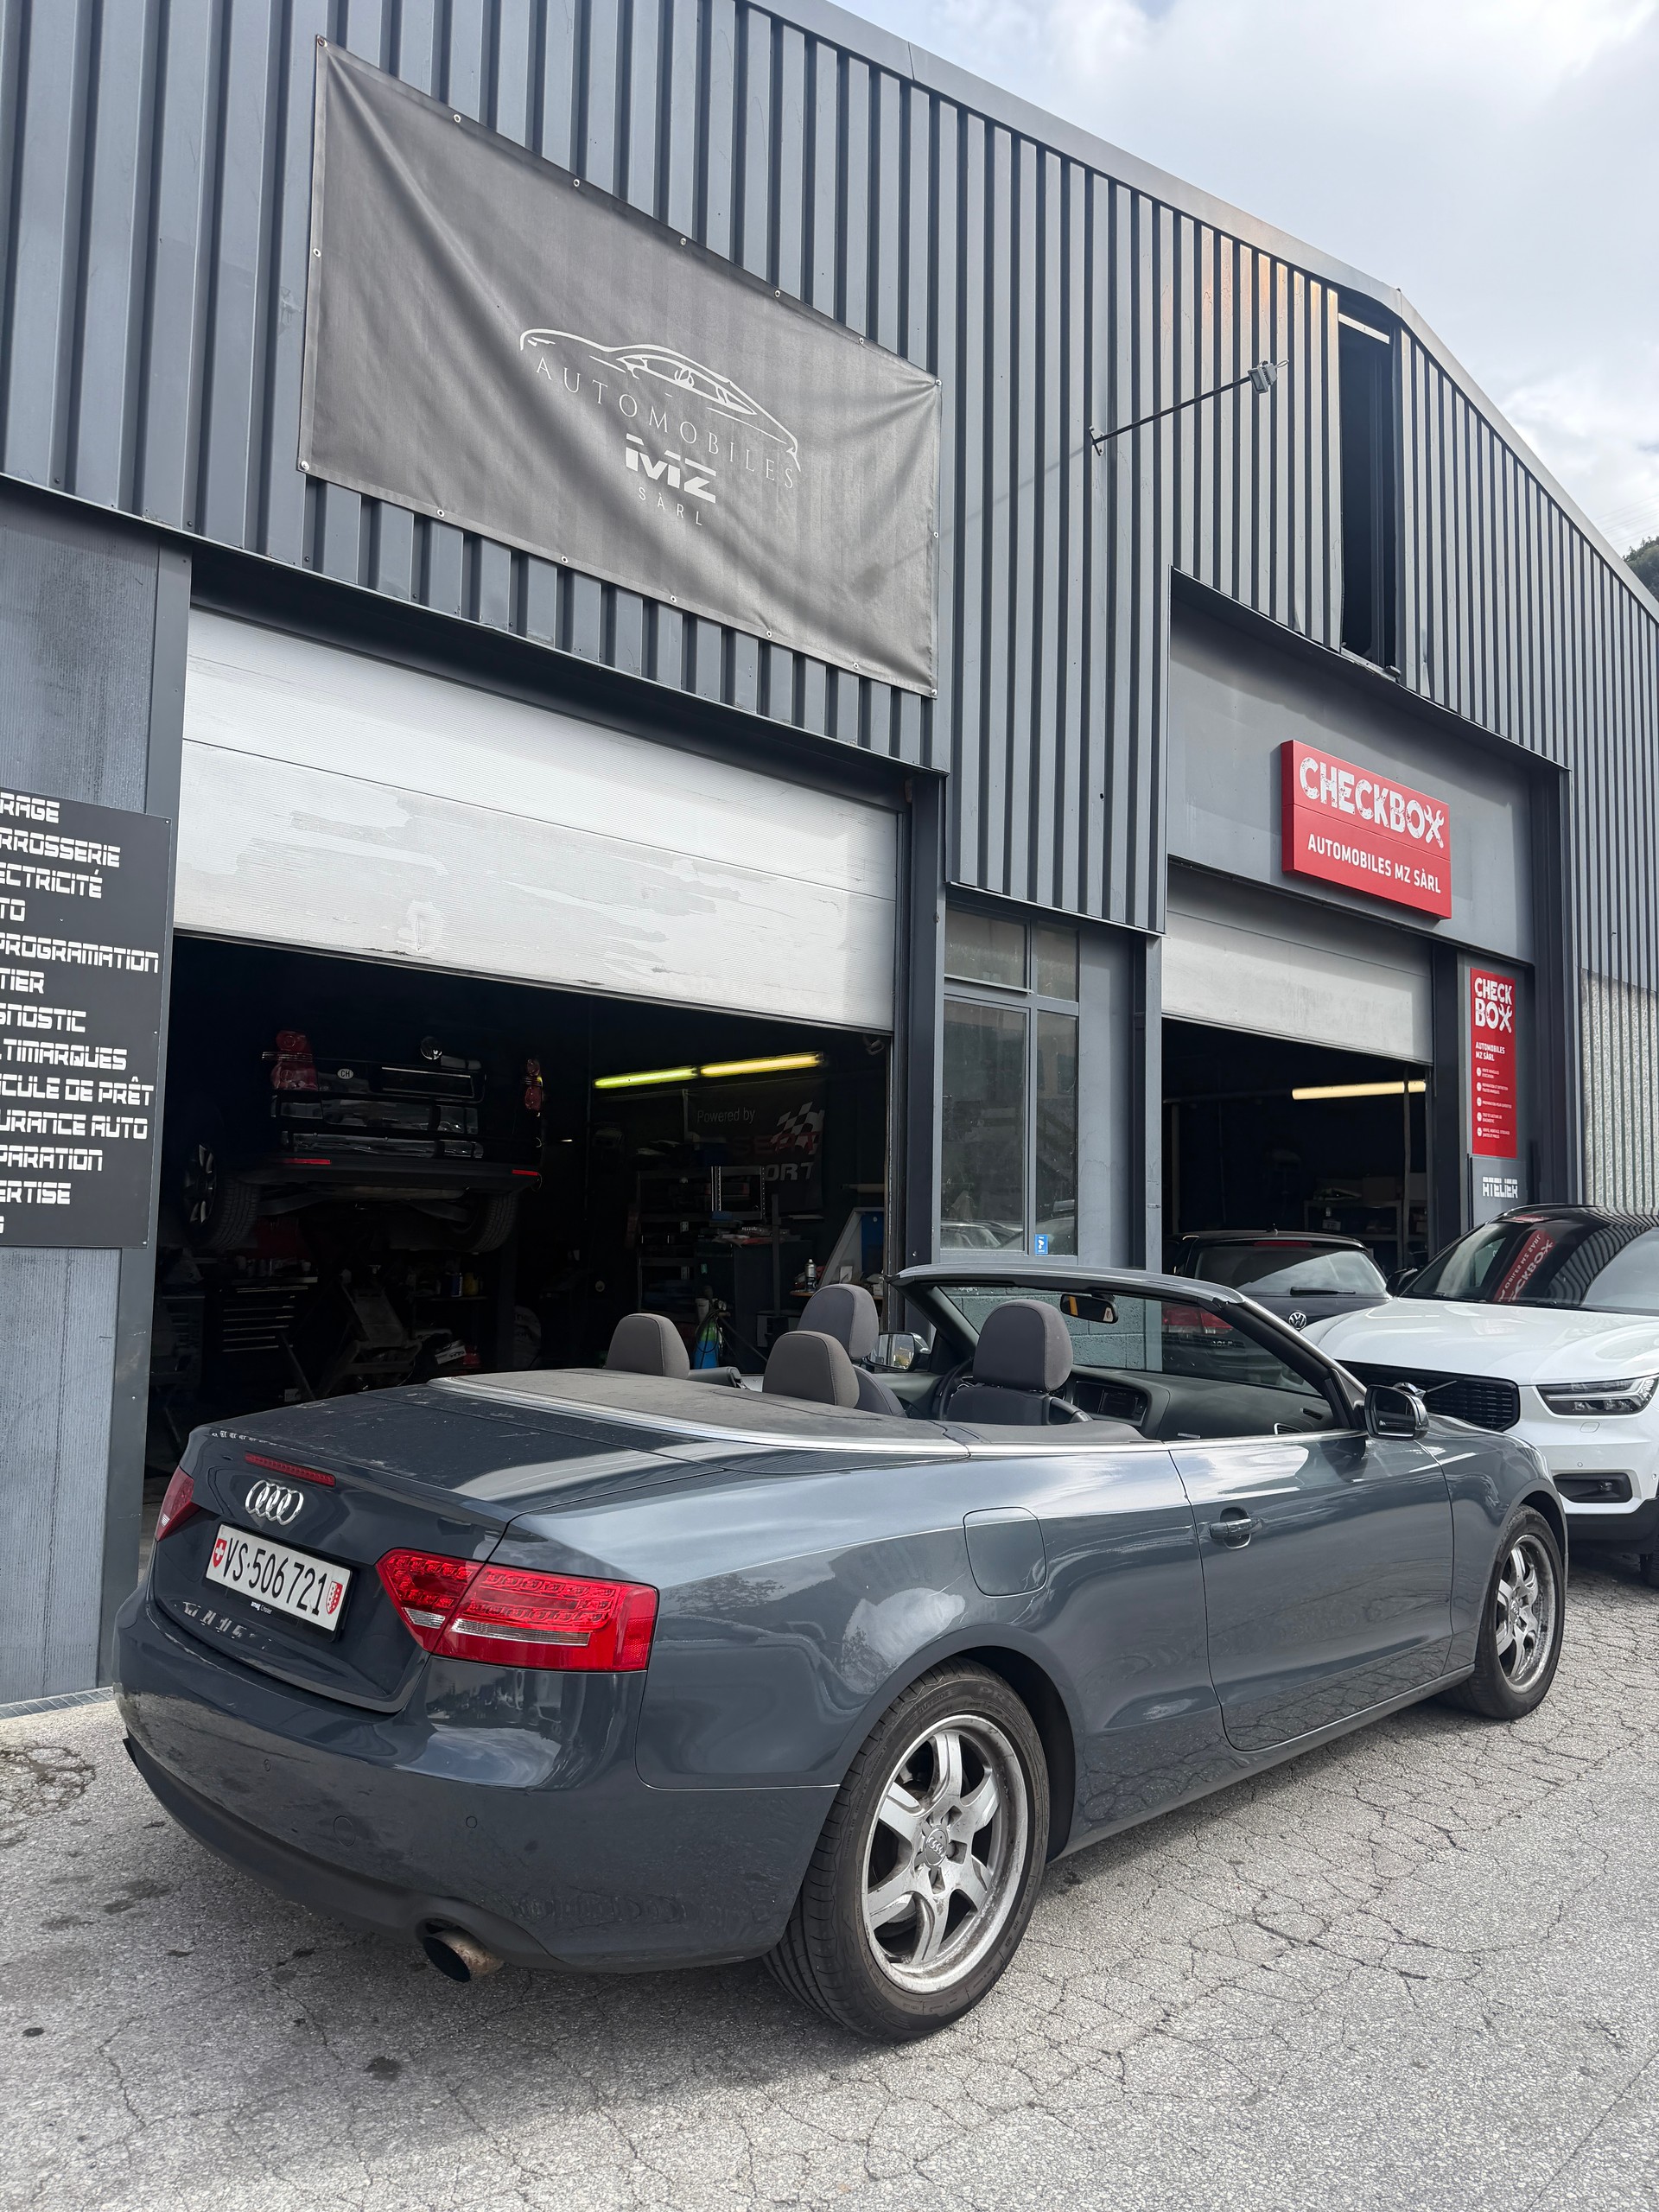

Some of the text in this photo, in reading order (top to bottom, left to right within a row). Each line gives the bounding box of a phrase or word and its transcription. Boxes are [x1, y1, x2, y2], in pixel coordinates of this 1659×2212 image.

[536, 356, 794, 489] AUTOMOBILES
[638, 486, 702, 526] SÀRL
[0, 791, 60, 824] RAGE
[1299, 756, 1445, 849] CHECKBOX
[0, 827, 121, 868] RROSSERIE
[1307, 833, 1441, 894] AUTOMOBILES MZ SÀRL
[1474, 976, 1513, 1006] CHECK
[1474, 997, 1513, 1034] BOX
[0, 1038, 128, 1071] TIMARQUES
[65, 1078, 94, 1103] DE
[98, 1076, 155, 1107] PRÊT
[91, 1115, 149, 1140] AUTO
[696, 1106, 756, 1124] Powered by
[764, 1161, 815, 1182] ORT
